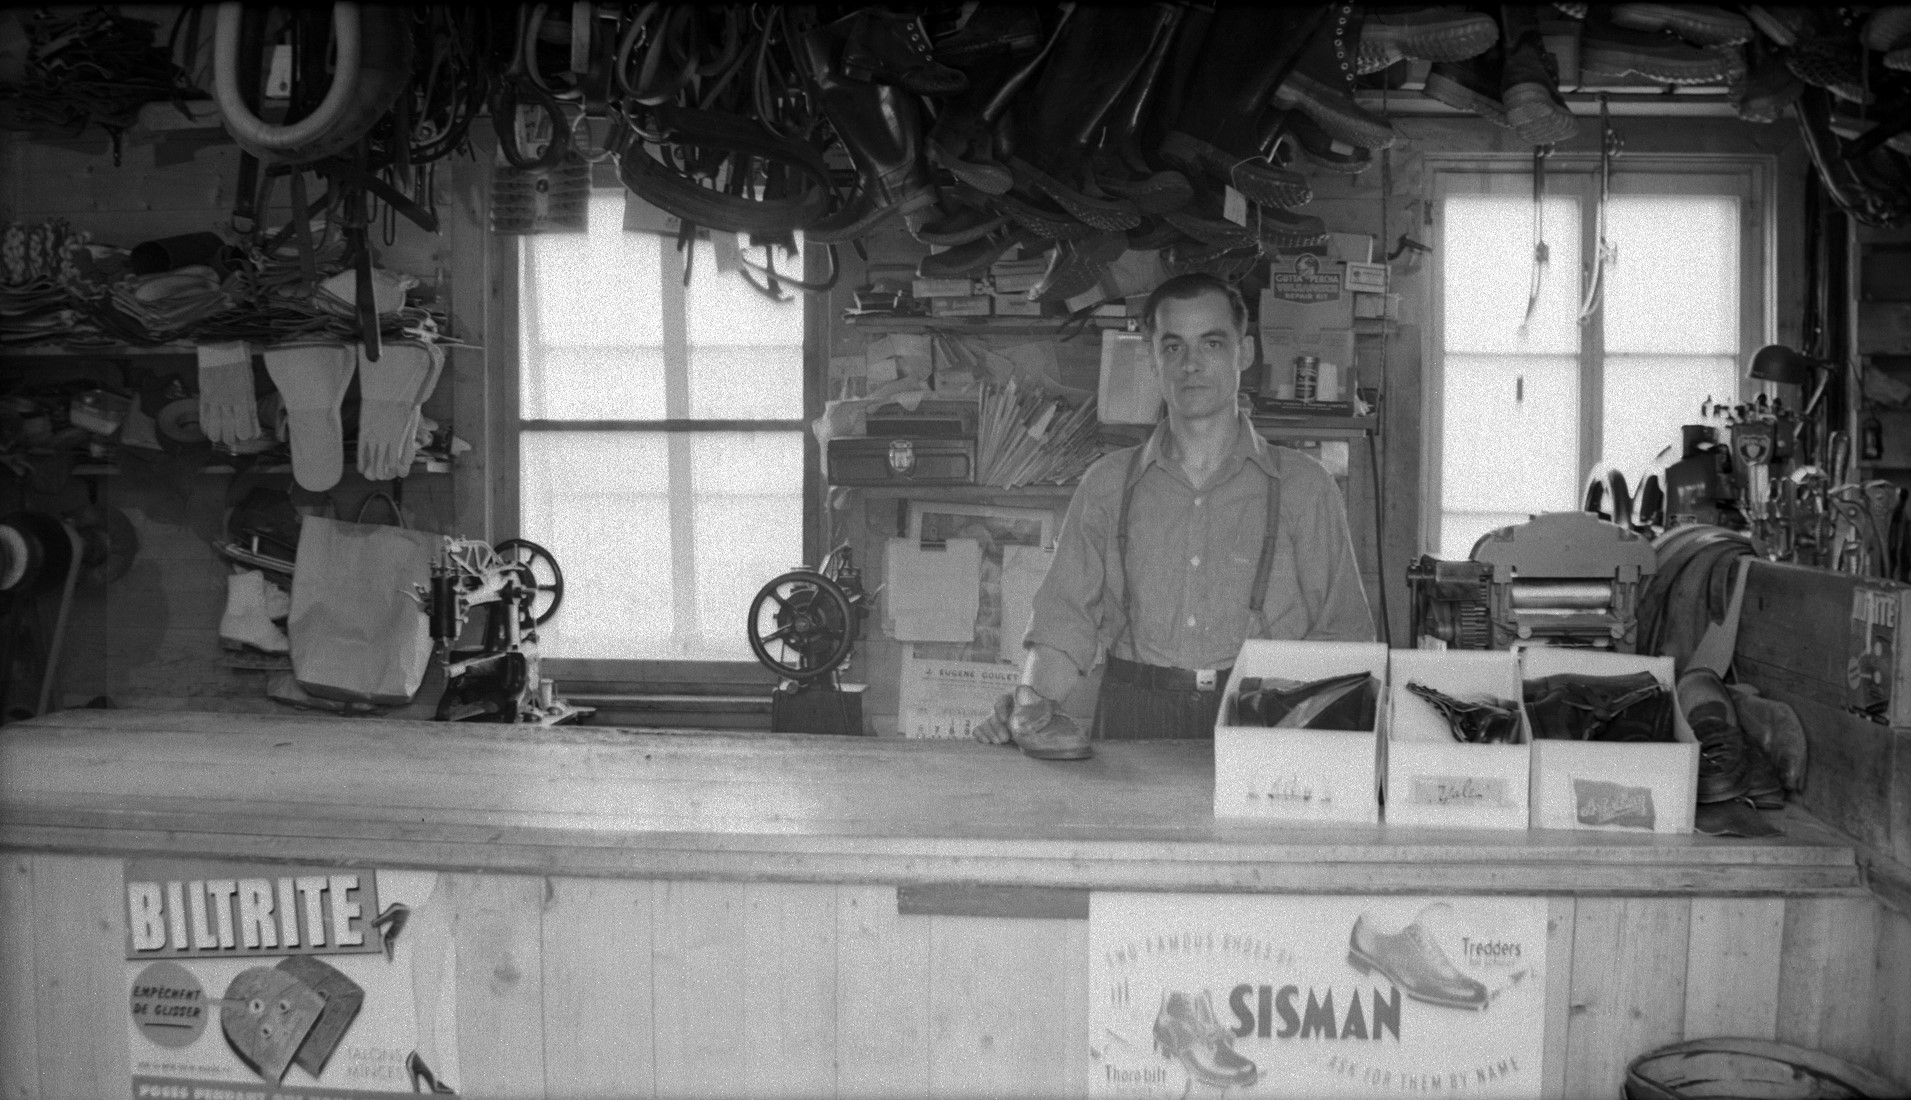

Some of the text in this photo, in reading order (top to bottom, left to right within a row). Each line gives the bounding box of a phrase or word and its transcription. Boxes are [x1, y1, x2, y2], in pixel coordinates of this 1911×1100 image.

[1275, 274, 1303, 283] GUTTA
[939, 668, 975, 678] EUGENE
[981, 671, 1019, 680] GOULET
[127, 875, 364, 951] BILTRITE
[1145, 932, 1214, 955] FAMOUS
[1222, 933, 1272, 961] SHOES
[1462, 937, 1521, 956] Tredders
[132, 1003, 201, 1018] DE GLISSER
[1229, 984, 1401, 1040] SISMAN
[1327, 1055, 1520, 1092] ASK FOR THEM BY NAME
